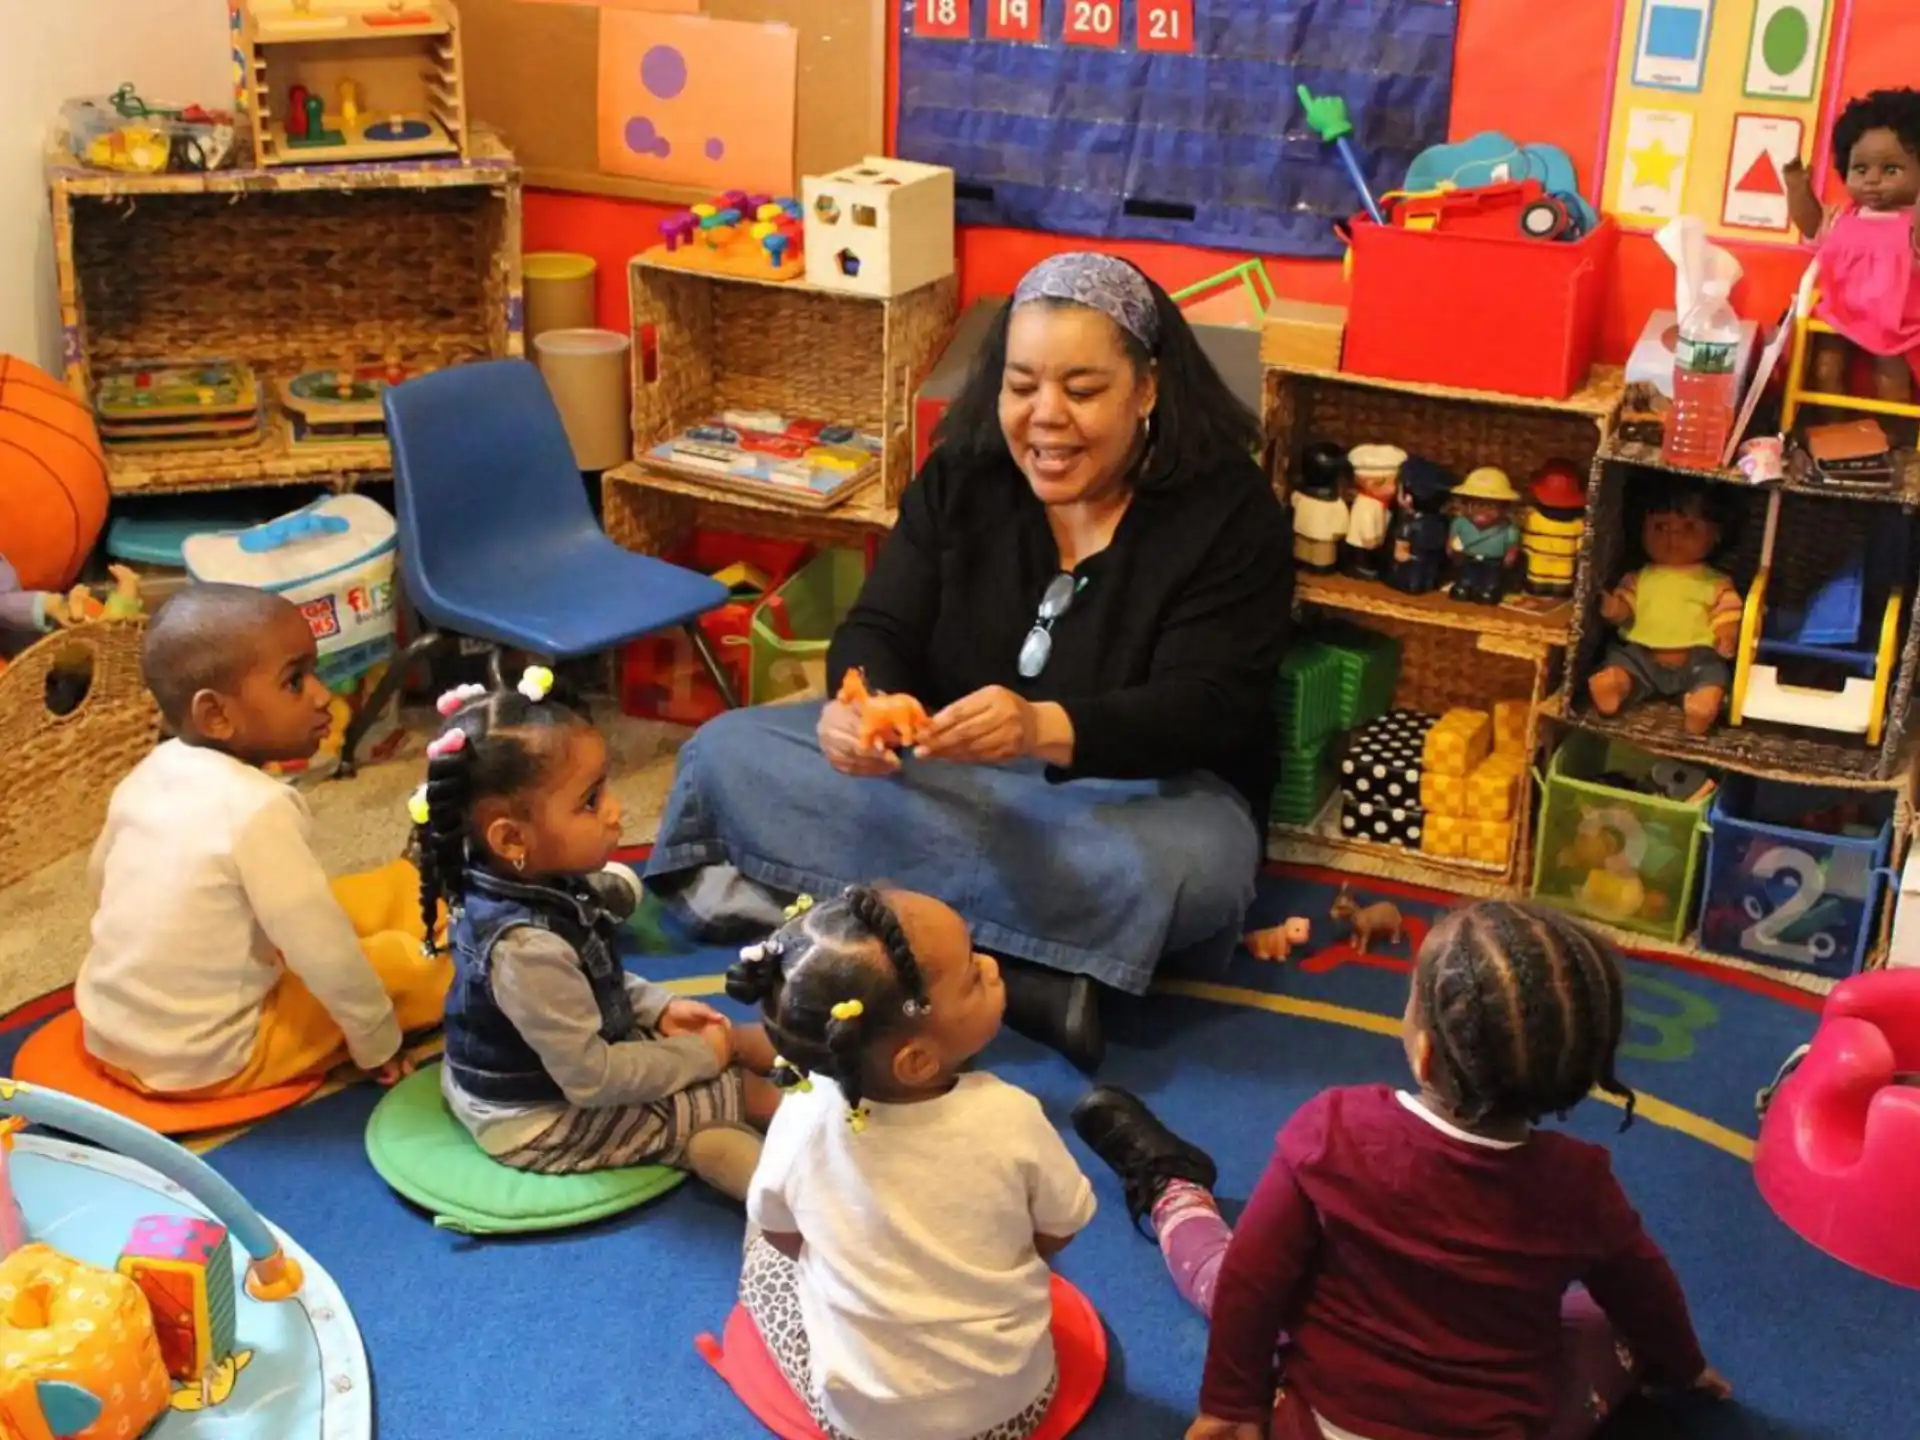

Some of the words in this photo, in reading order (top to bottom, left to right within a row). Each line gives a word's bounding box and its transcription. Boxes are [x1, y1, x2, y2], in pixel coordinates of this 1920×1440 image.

[925, 0, 956, 25] 18
[999, 0, 1028, 28] 19
[1073, 2, 1112, 33] 20
[1148, 8, 1179, 39] 21
[1740, 845, 1826, 965] 2
